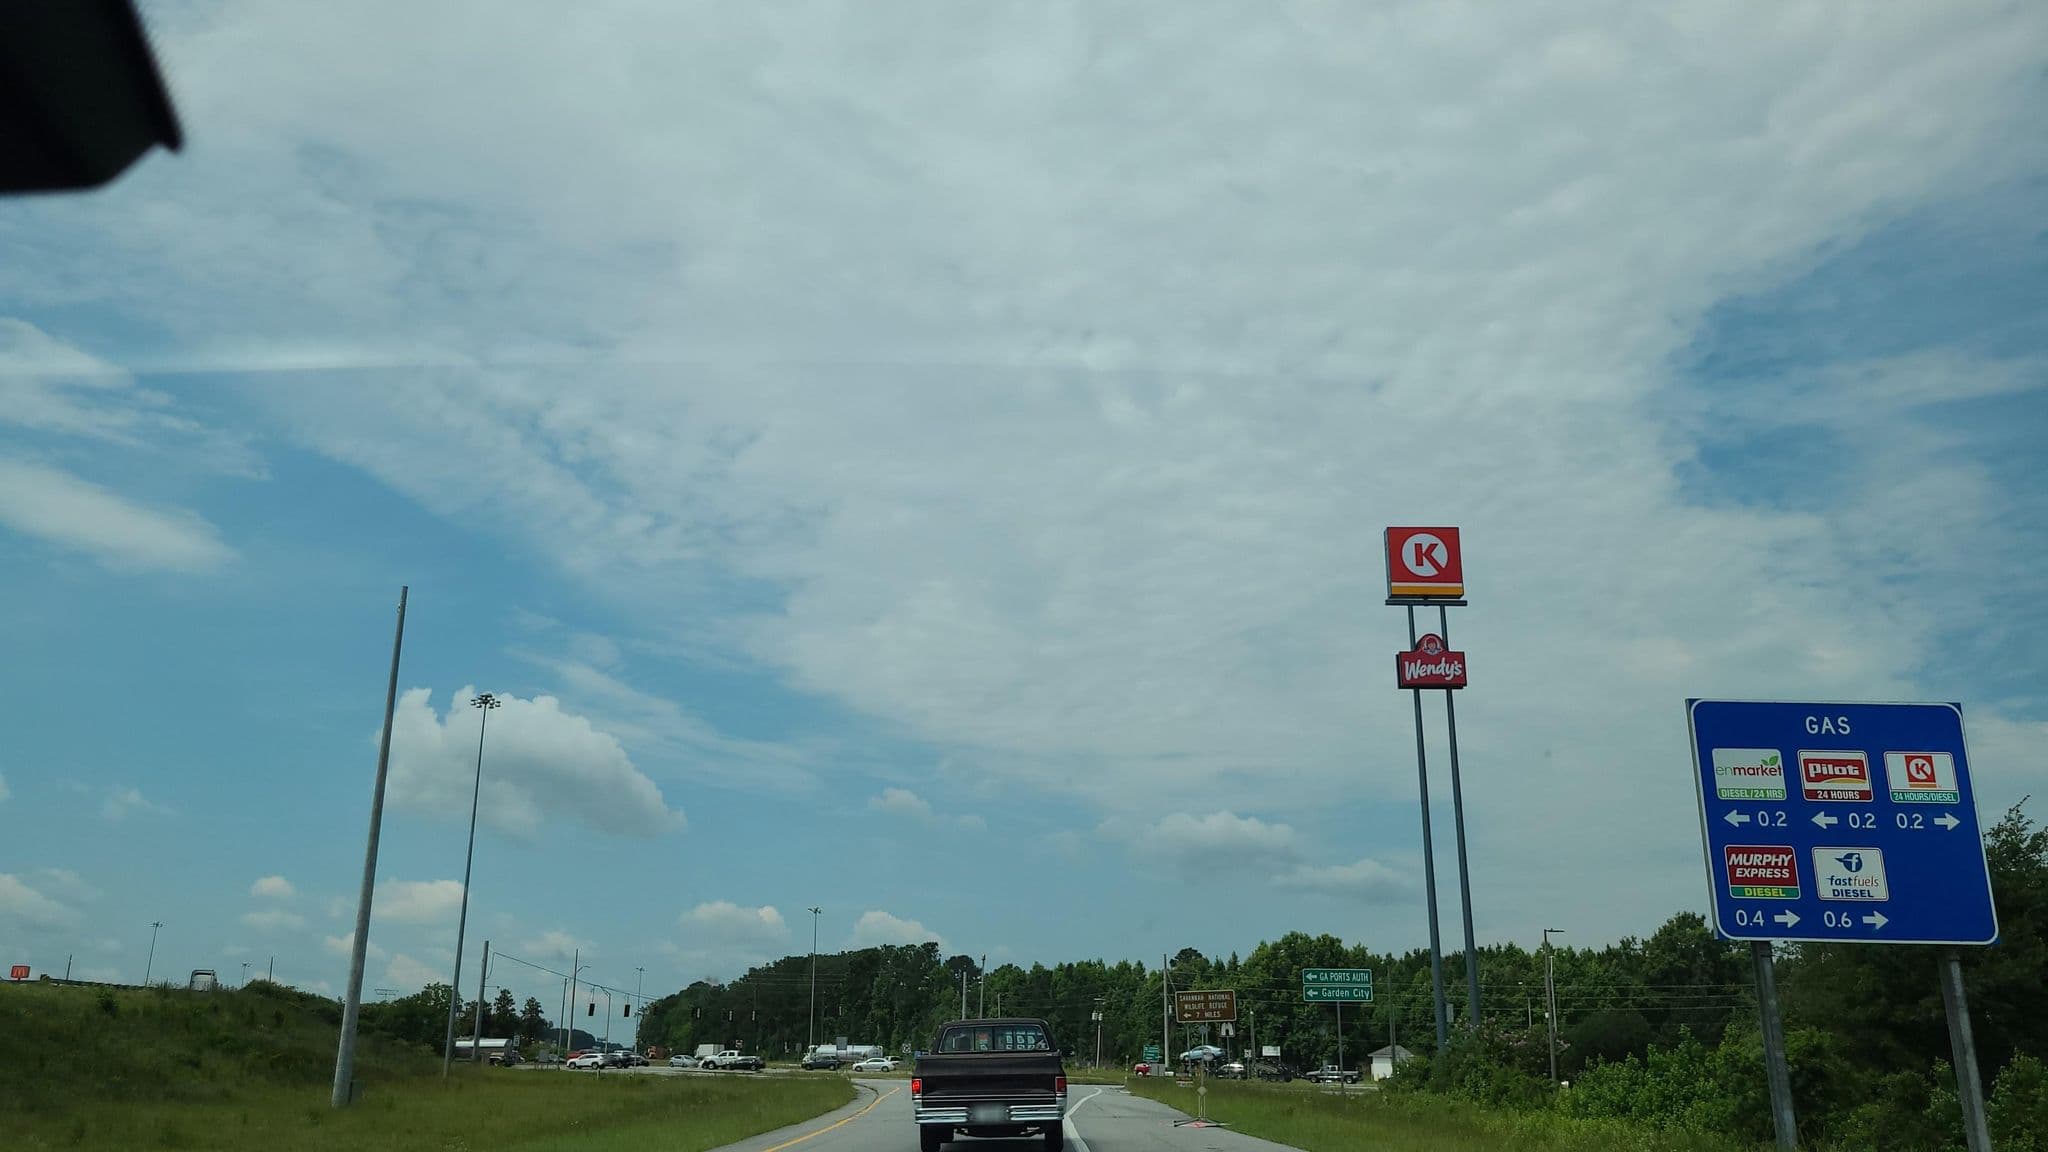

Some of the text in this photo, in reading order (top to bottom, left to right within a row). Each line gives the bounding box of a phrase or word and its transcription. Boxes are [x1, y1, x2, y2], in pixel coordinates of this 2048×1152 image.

[1404, 657, 1462, 681] Wendy's
[1805, 716, 1851, 735] GAS
[1715, 760, 1783, 777] enmarket
[1808, 762, 1860, 777] Pilot
[1721, 788, 1784, 799] DIESEL/24 HRS
[1817, 790, 1860, 800] 24 HOURS
[1893, 792, 1957, 802] 24 HOURS/DIESEL
[1757, 811, 1787, 827] 0.2
[1848, 813, 1877, 829] 0.2
[1896, 813, 1924, 829] 0.2
[1729, 854, 1792, 867] MURPHY
[1736, 868, 1790, 879] EXPRESS
[1744, 887, 1786, 897] DIESEL
[1832, 889, 1874, 898] DIESEL
[1736, 910, 1765, 927] 0.4
[1823, 911, 1852, 928] 0.6
[1319, 972, 1369, 982] GA PORTS AUTH
[1321, 988, 1370, 999] Garden City
